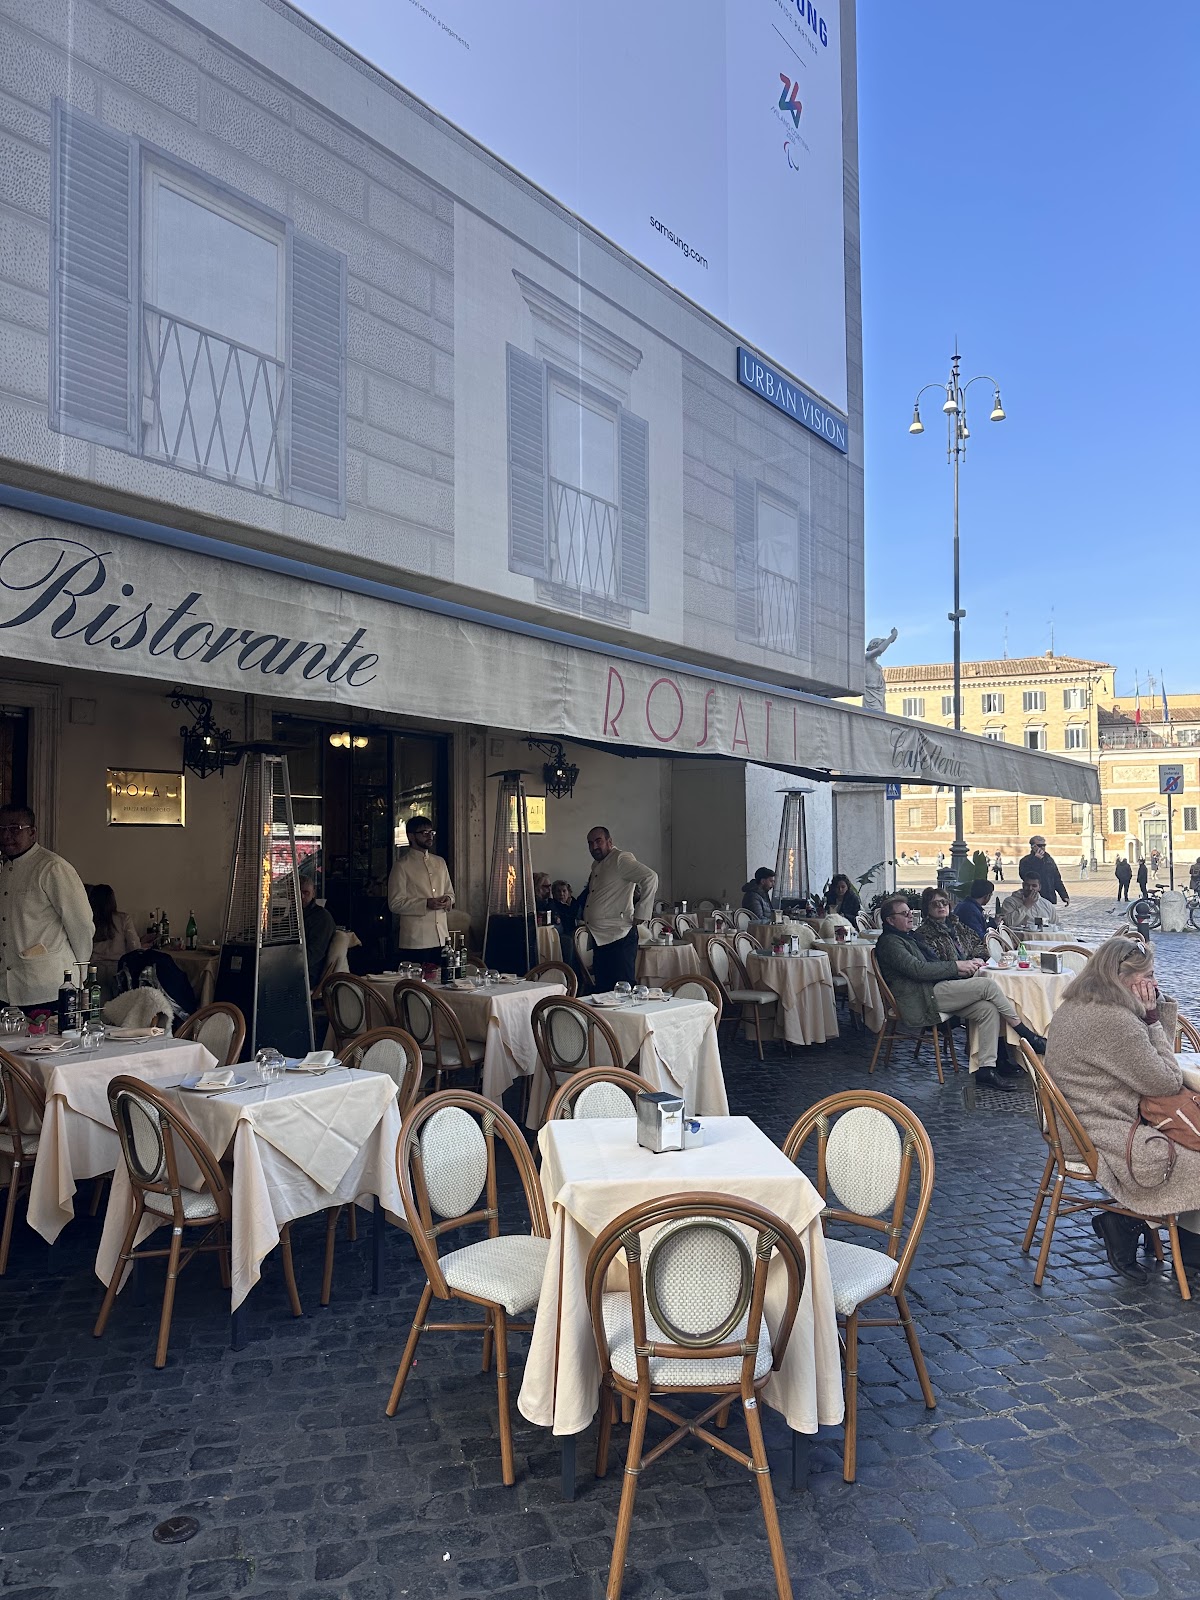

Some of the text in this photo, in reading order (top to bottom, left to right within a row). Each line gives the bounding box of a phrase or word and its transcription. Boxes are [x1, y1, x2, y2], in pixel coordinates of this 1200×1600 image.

[790, 0, 827, 47] UNG
[794, 20, 818, 55] PARTNER
[650, 215, 708, 270] samsung.com
[743, 356, 845, 447] URBAN VISION
[0, 537, 379, 687] Ristorante
[603, 666, 797, 761] ROSATI
